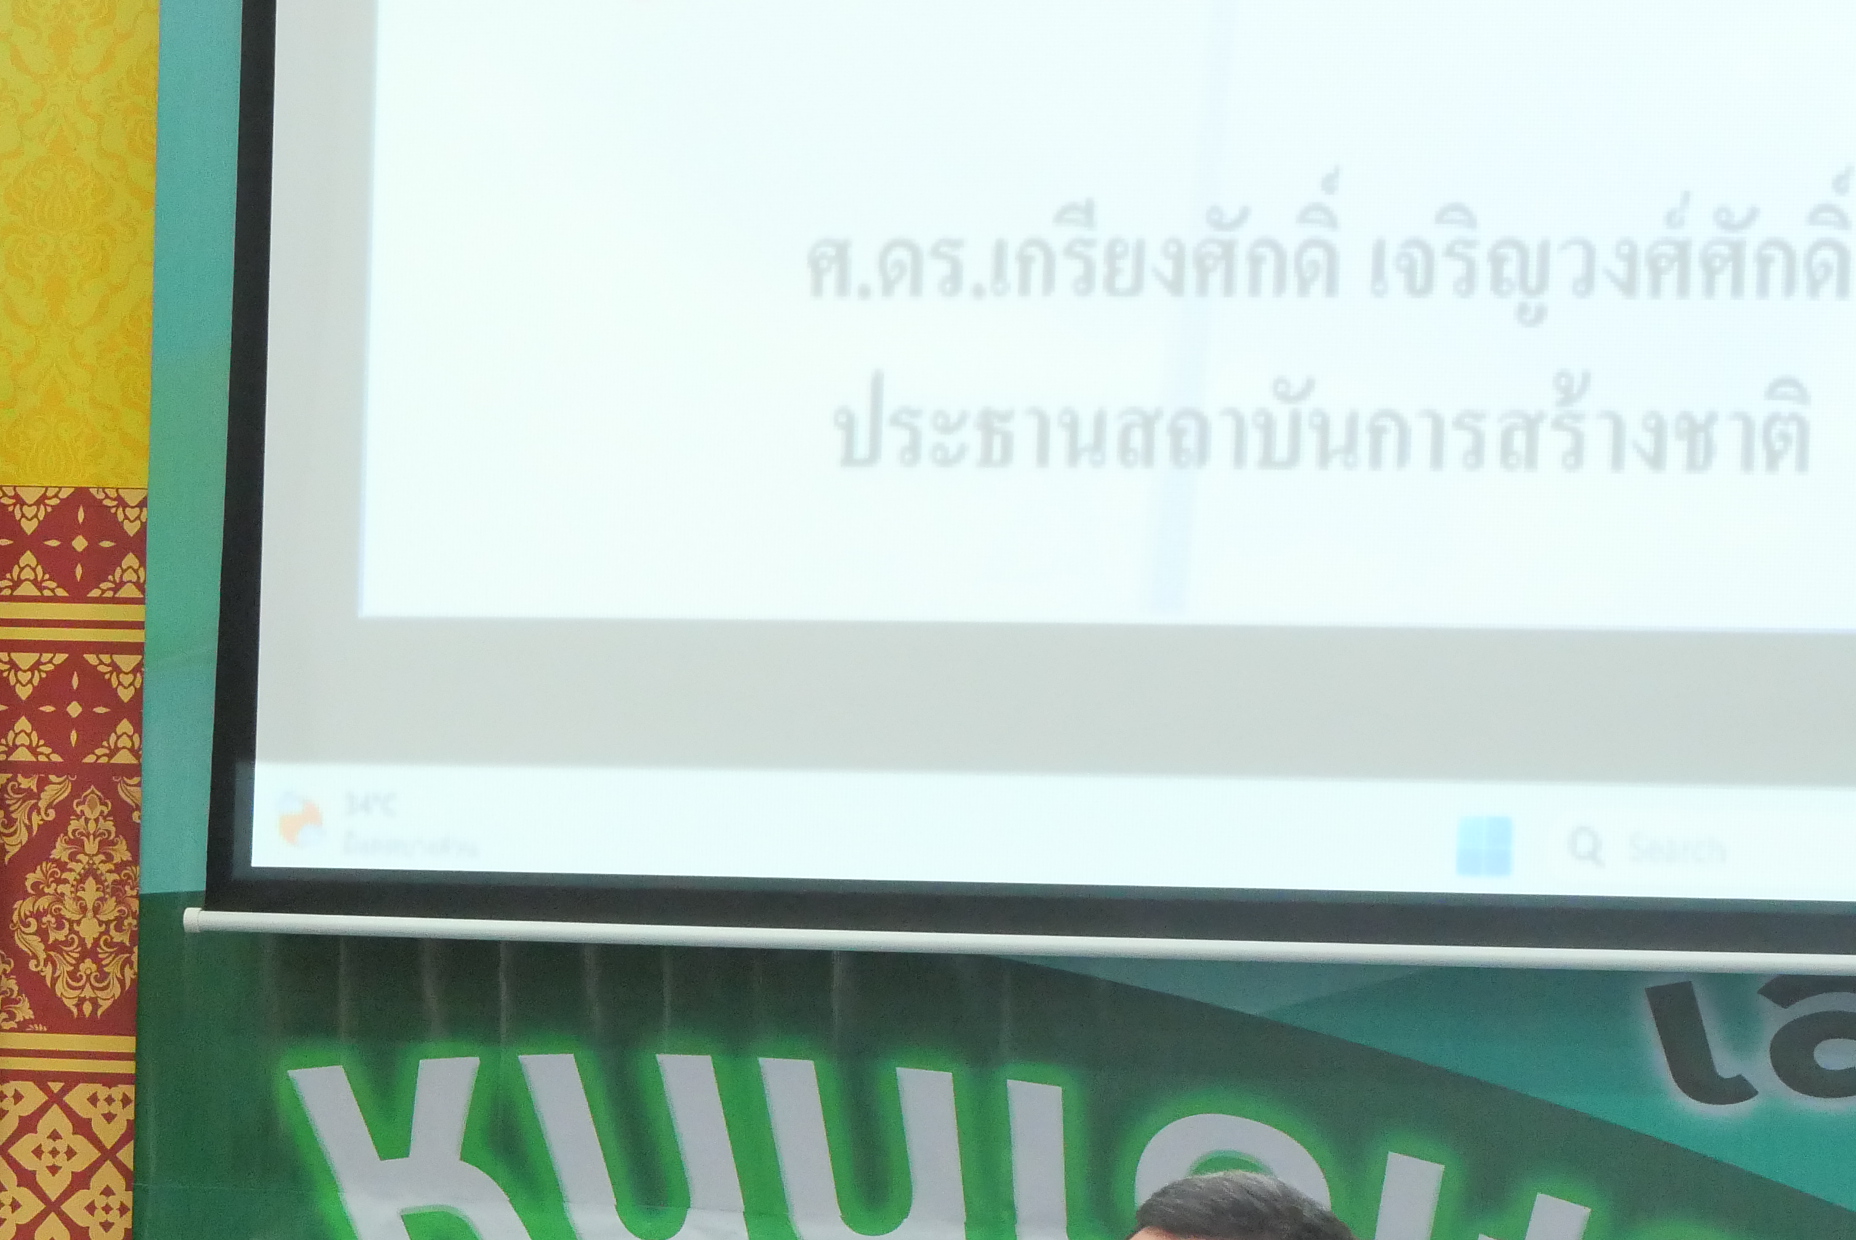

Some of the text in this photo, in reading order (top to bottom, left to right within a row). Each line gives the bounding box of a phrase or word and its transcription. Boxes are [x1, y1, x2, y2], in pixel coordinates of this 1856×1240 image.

[806, 164, 1854, 328] ศ.ดร.เกรียงศักดิ์ เจริญวงศ์ศักดิ์
[833, 367, 1812, 474] ประธานสถาบันการสร้างชาติ
[1628, 830, 1727, 866] Search
